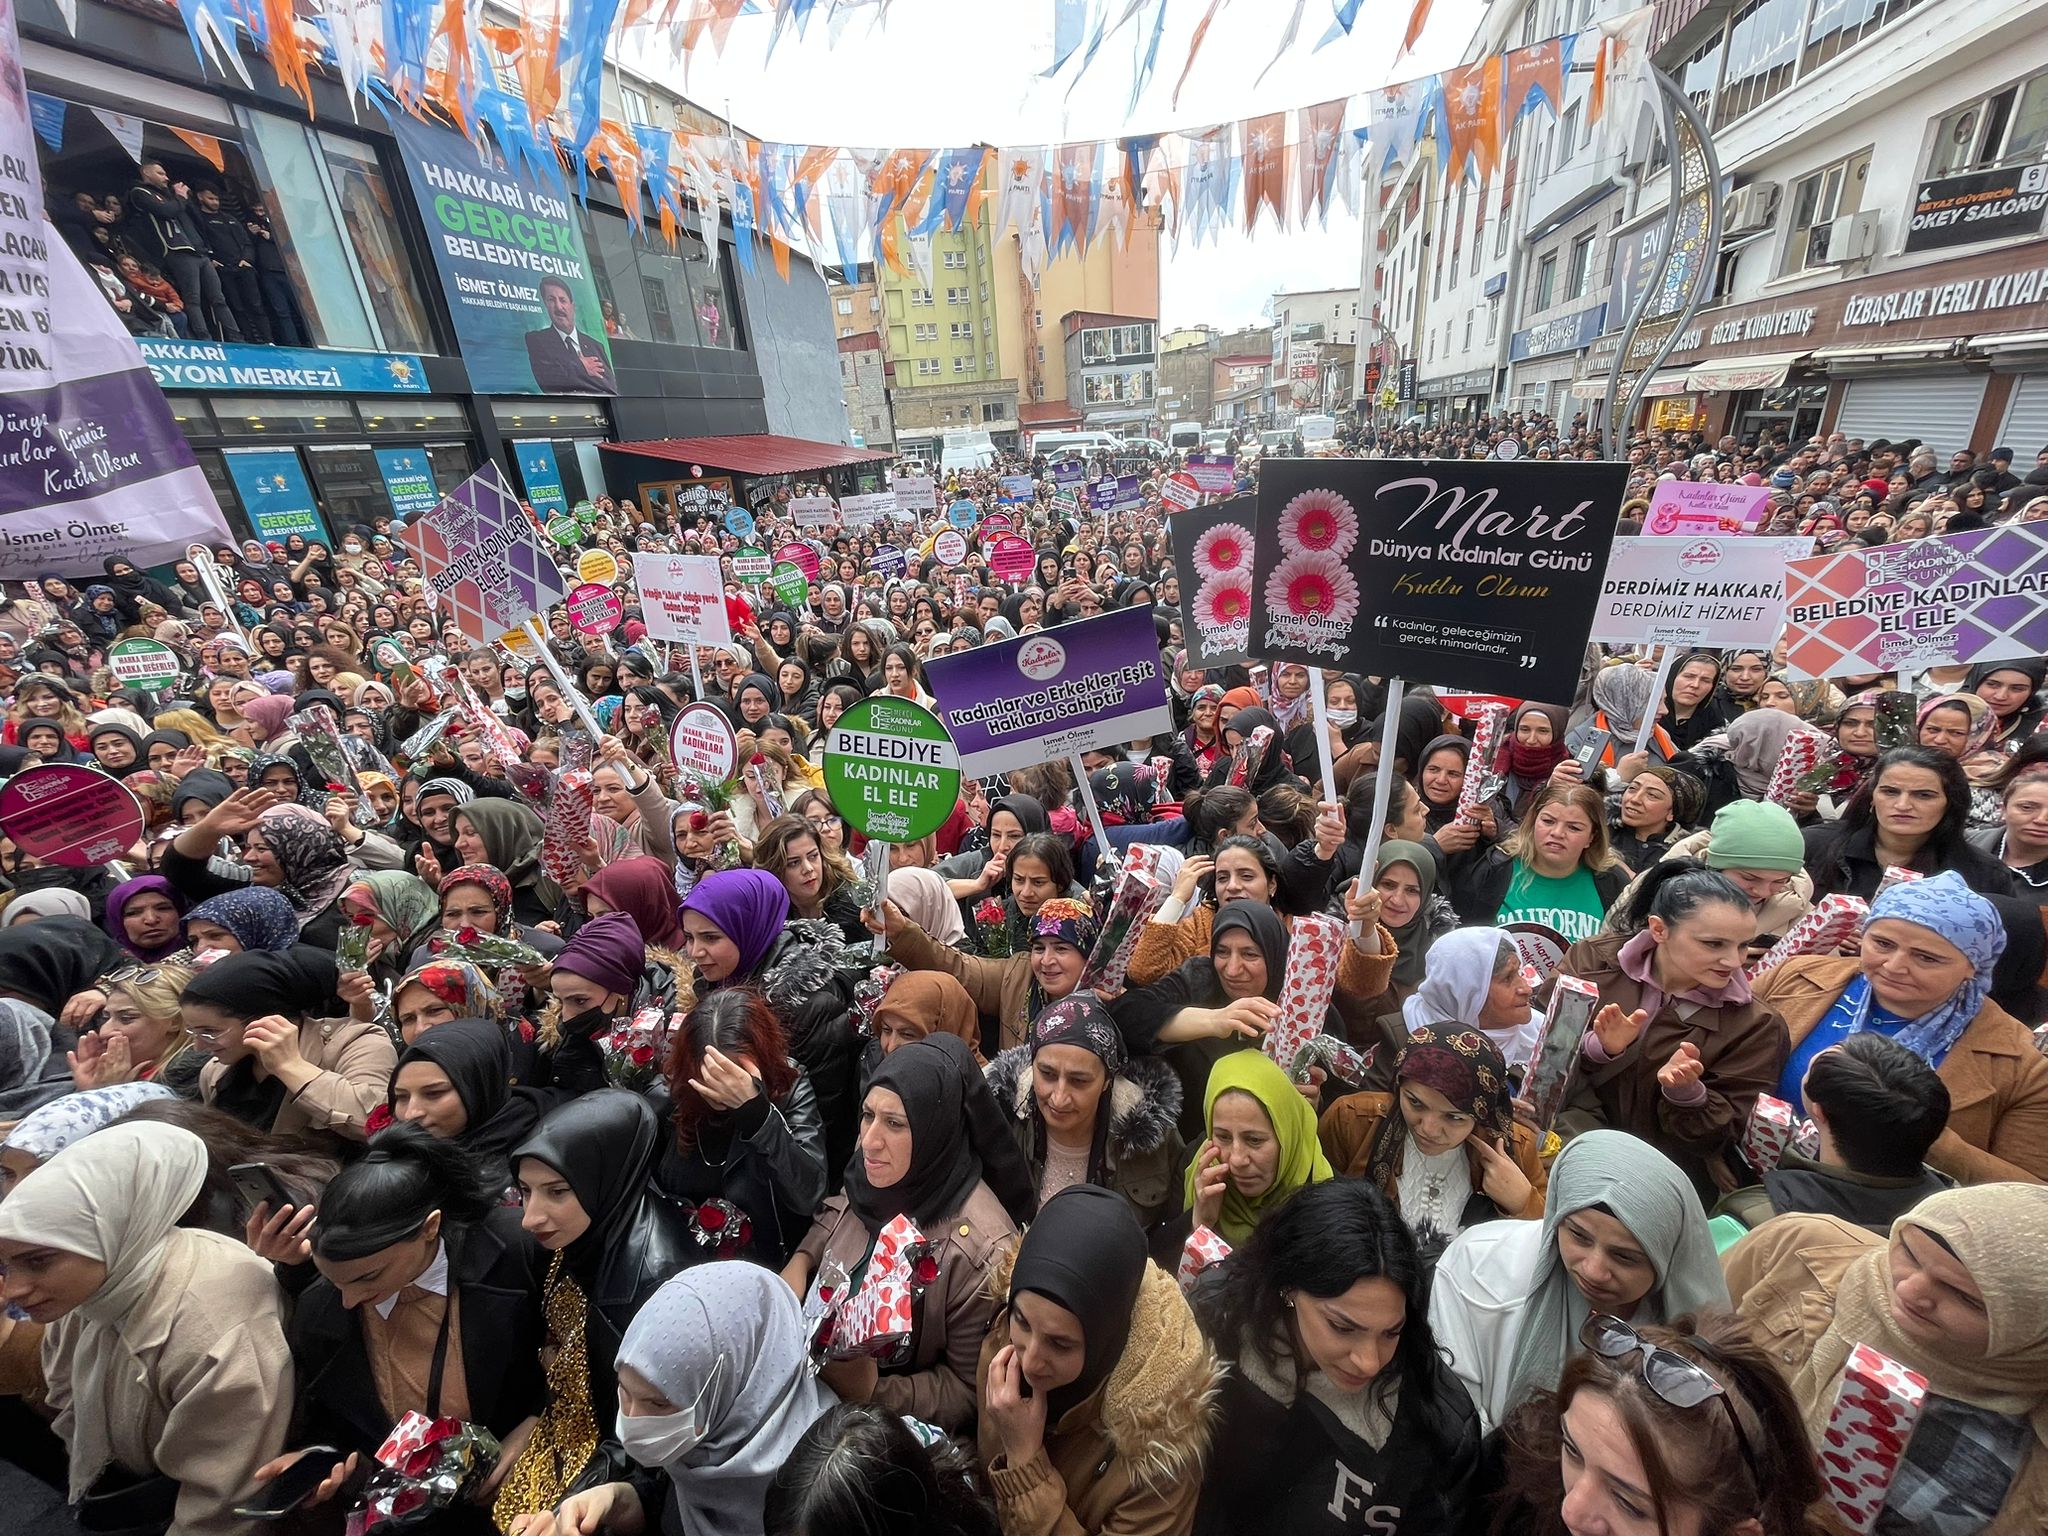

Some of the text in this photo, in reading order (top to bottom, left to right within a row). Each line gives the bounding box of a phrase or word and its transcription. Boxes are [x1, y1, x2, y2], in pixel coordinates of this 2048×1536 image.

[0, 154, 29, 184] AK
[2028, 167, 2040, 180] 6
[421, 161, 568, 221] HAKKARİ İÇİN
[1955, 187, 2015, 205] GÜVERCİN
[1911, 194, 2048, 232] OKEY SALONU
[434, 194, 578, 258] GERÇEK
[443, 234, 584, 280] BELEDİYECİLİK
[455, 272, 540, 302] İSMET ÖLMEZ
[1843, 289, 1926, 328] ÖZBAŞLAR
[1710, 320, 1742, 345] GÖZDE
[0, 341, 52, 370] İM.
[141, 343, 226, 362] AKKARİ
[149, 364, 342, 388] SYON MERKEZİ
[391, 482, 432, 496] GERÇEK
[259, 513, 315, 529] GERÇEK
[1375, 477, 1594, 550] Mart
[2, 520, 129, 546] İsmet Ölmez
[262, 524, 317, 537] BELEDİYECİLİK
[431, 515, 530, 594] BELEDİYE KADINLAR
[1370, 539, 1593, 572] Dünya Kadınlar Günü
[1906, 552, 1976, 570] KADINLAR
[475, 561, 509, 593] EL ELE
[1392, 572, 1550, 597] Kutlu Olsun
[1604, 578, 1783, 601] DERDİMİZ HAKKARİ,
[1269, 606, 1351, 631] İsmet Ölmez
[1610, 600, 1766, 621] DERDİMİZ HİZMET
[1793, 592, 1904, 623] BELEDİYE
[1201, 623, 1230, 636] İsmet
[1392, 618, 1522, 644] Kadınlar, geleceğimizin
[1881, 609, 1956, 633] EL ELE
[1399, 633, 1509, 655] gerçek mimarlarıdır.
[1881, 633, 1958, 648] İsmet Ölmez
[951, 661, 1155, 727] Kadınlar ve Erkekler Eşit
[890, 716, 922, 727] KADINLAR
[988, 688, 1125, 735] Haklara Sahiptir
[839, 733, 942, 764] BELEDİYE
[1043, 728, 1095, 746] İsmet Ölmez
[844, 762, 940, 790] KADINLAR
[863, 785, 918, 808] EL ELE
[1497, 907, 1601, 941] CALIFORNI
